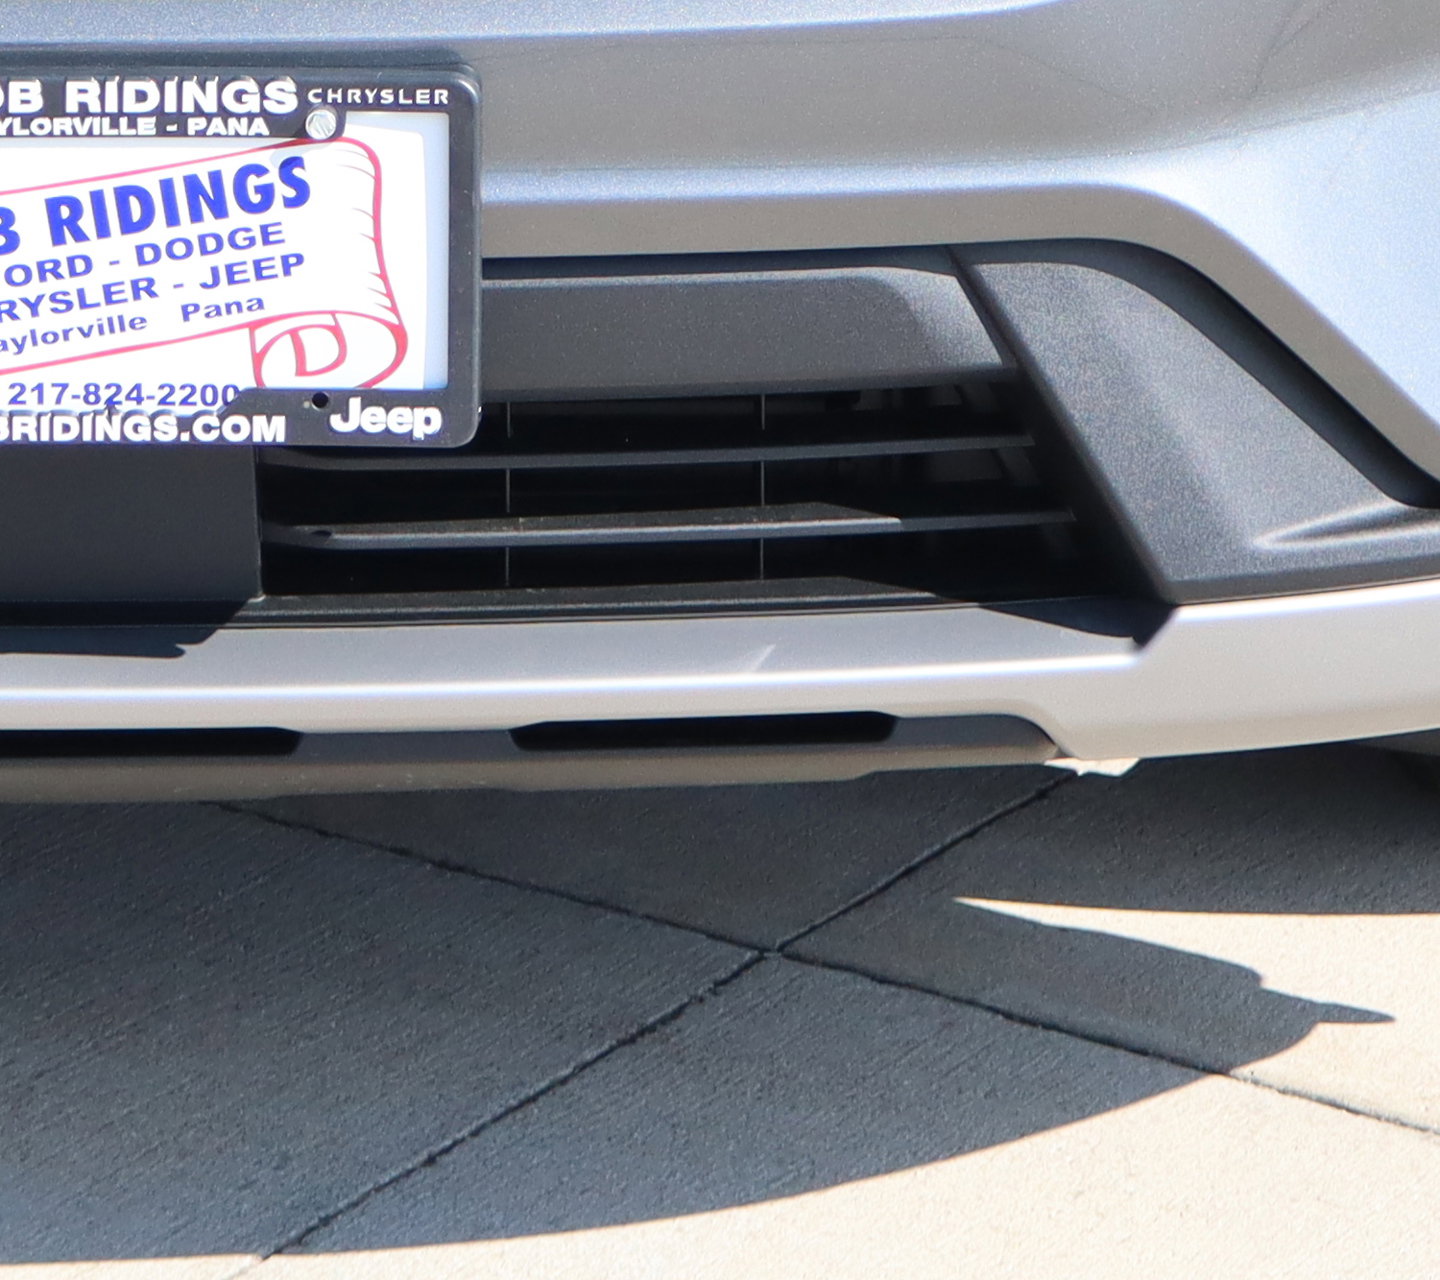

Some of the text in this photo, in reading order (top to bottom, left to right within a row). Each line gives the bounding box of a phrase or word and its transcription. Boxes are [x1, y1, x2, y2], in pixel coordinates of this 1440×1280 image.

[65, 77, 298, 115] RIDINGS
[307, 88, 449, 105] CHRYSLER
[187, 116, 270, 136] PANA
[44, 155, 311, 247] RIDINGS
[135, 222, 286, 268] DODGE
[199, 252, 306, 290] JEEP
[180, 296, 266, 323] Pana
[7, 382, 242, 407] 217-824-2200
[330, 397, 443, 440] Jeep
